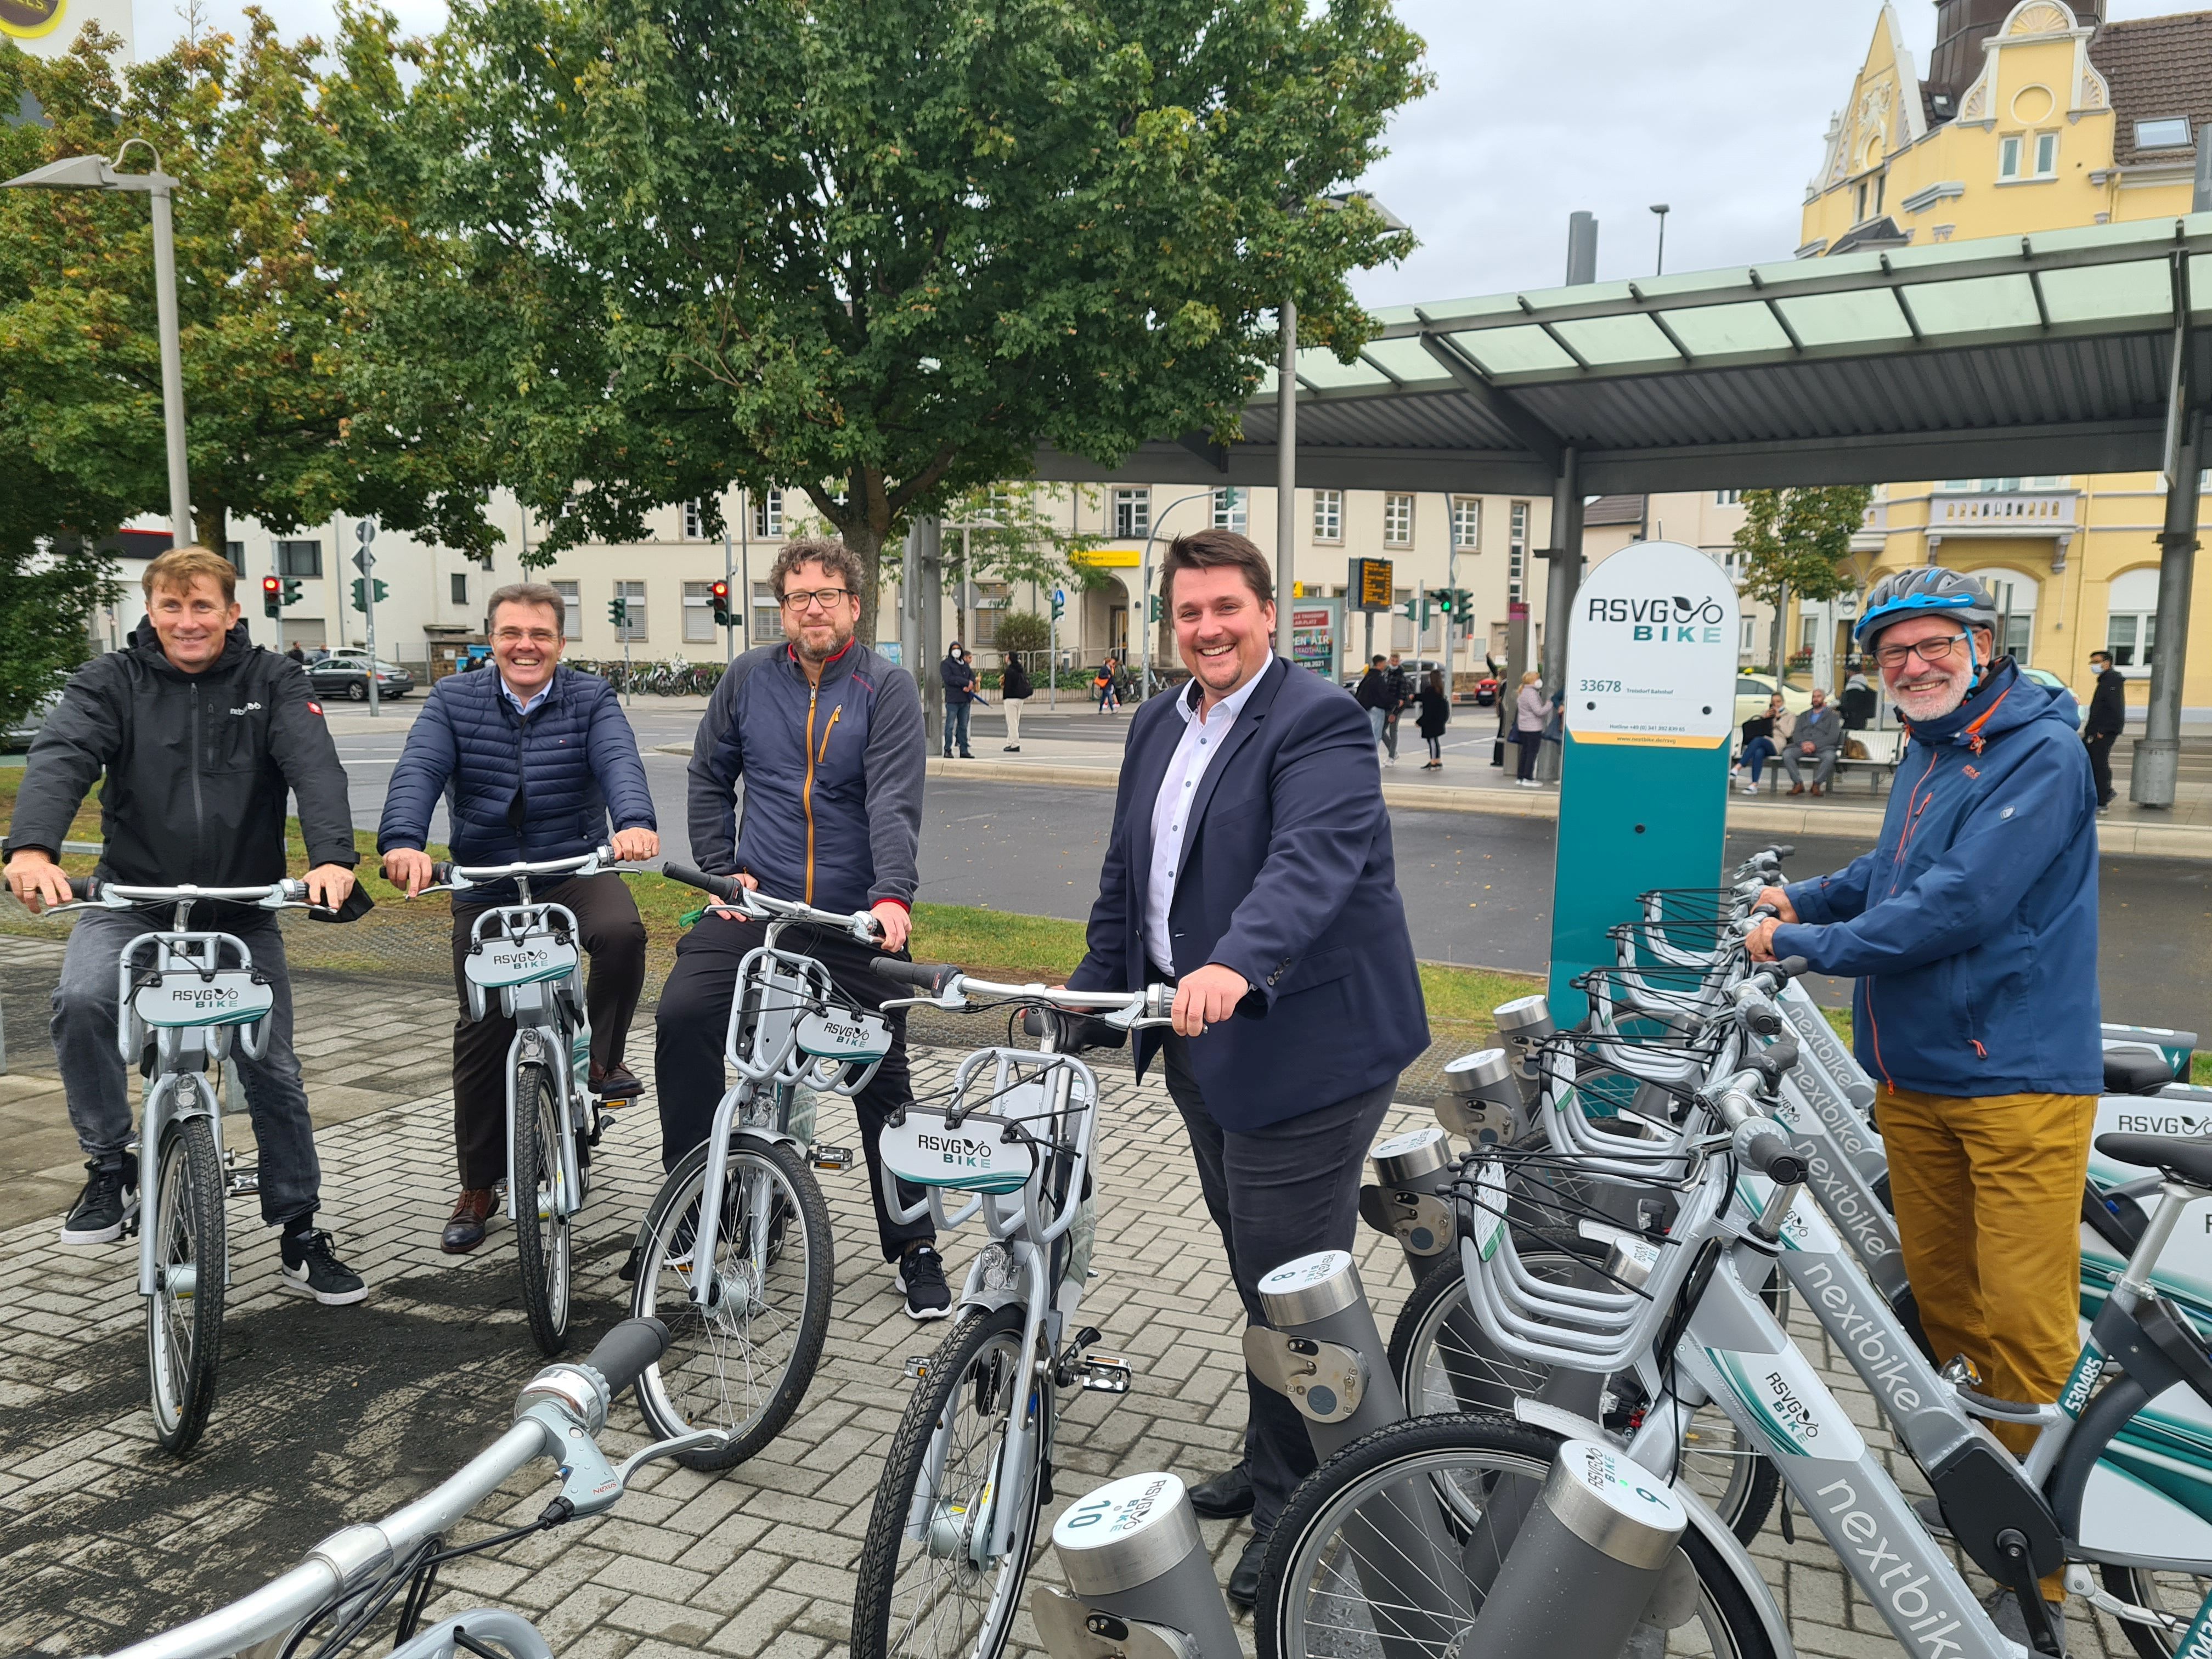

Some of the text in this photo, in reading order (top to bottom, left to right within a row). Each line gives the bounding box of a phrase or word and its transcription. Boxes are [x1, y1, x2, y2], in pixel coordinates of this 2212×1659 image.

[1589, 599, 1668, 623] RSVG
[1633, 625, 1722, 643] BIKE
[1579, 680, 1622, 692] 33678
[493, 953, 527, 965] RSVG
[513, 960, 549, 969] BIKE
[172, 990, 213, 1001] RSVG
[195, 1000, 238, 1008] BIKE
[823, 1022, 854, 1037] RSVG
[836, 1036, 867, 1048] BIKE
[1788, 1006, 1852, 1087] nextbike
[1792, 1059, 1862, 1153] nextbike
[2118, 1114, 2178, 1134] RSVG
[918, 1134, 961, 1154] RSVG
[943, 1153, 991, 1169] BIKE
[1795, 1139, 1886, 1256] nextbike
[1318, 1253, 1336, 1271] RSVG
[1271, 1272, 1296, 1282] 8
[1305, 1264, 1319, 1283] BIKE
[1803, 1262, 1921, 1412] nextbike
[1765, 1372, 1802, 1414] RSVG
[2064, 1356, 2104, 1413] 530485
[1772, 1400, 1809, 1444] BIKE
[1588, 1460, 1604, 1491] RSVG
[1604, 1454, 1616, 1483] BIKE
[1135, 1479, 1167, 1510] RSVG
[1068, 1500, 1111, 1528] 10
[1109, 1498, 1140, 1532] BIKE
[1816, 1478, 1966, 1659] nextbik
